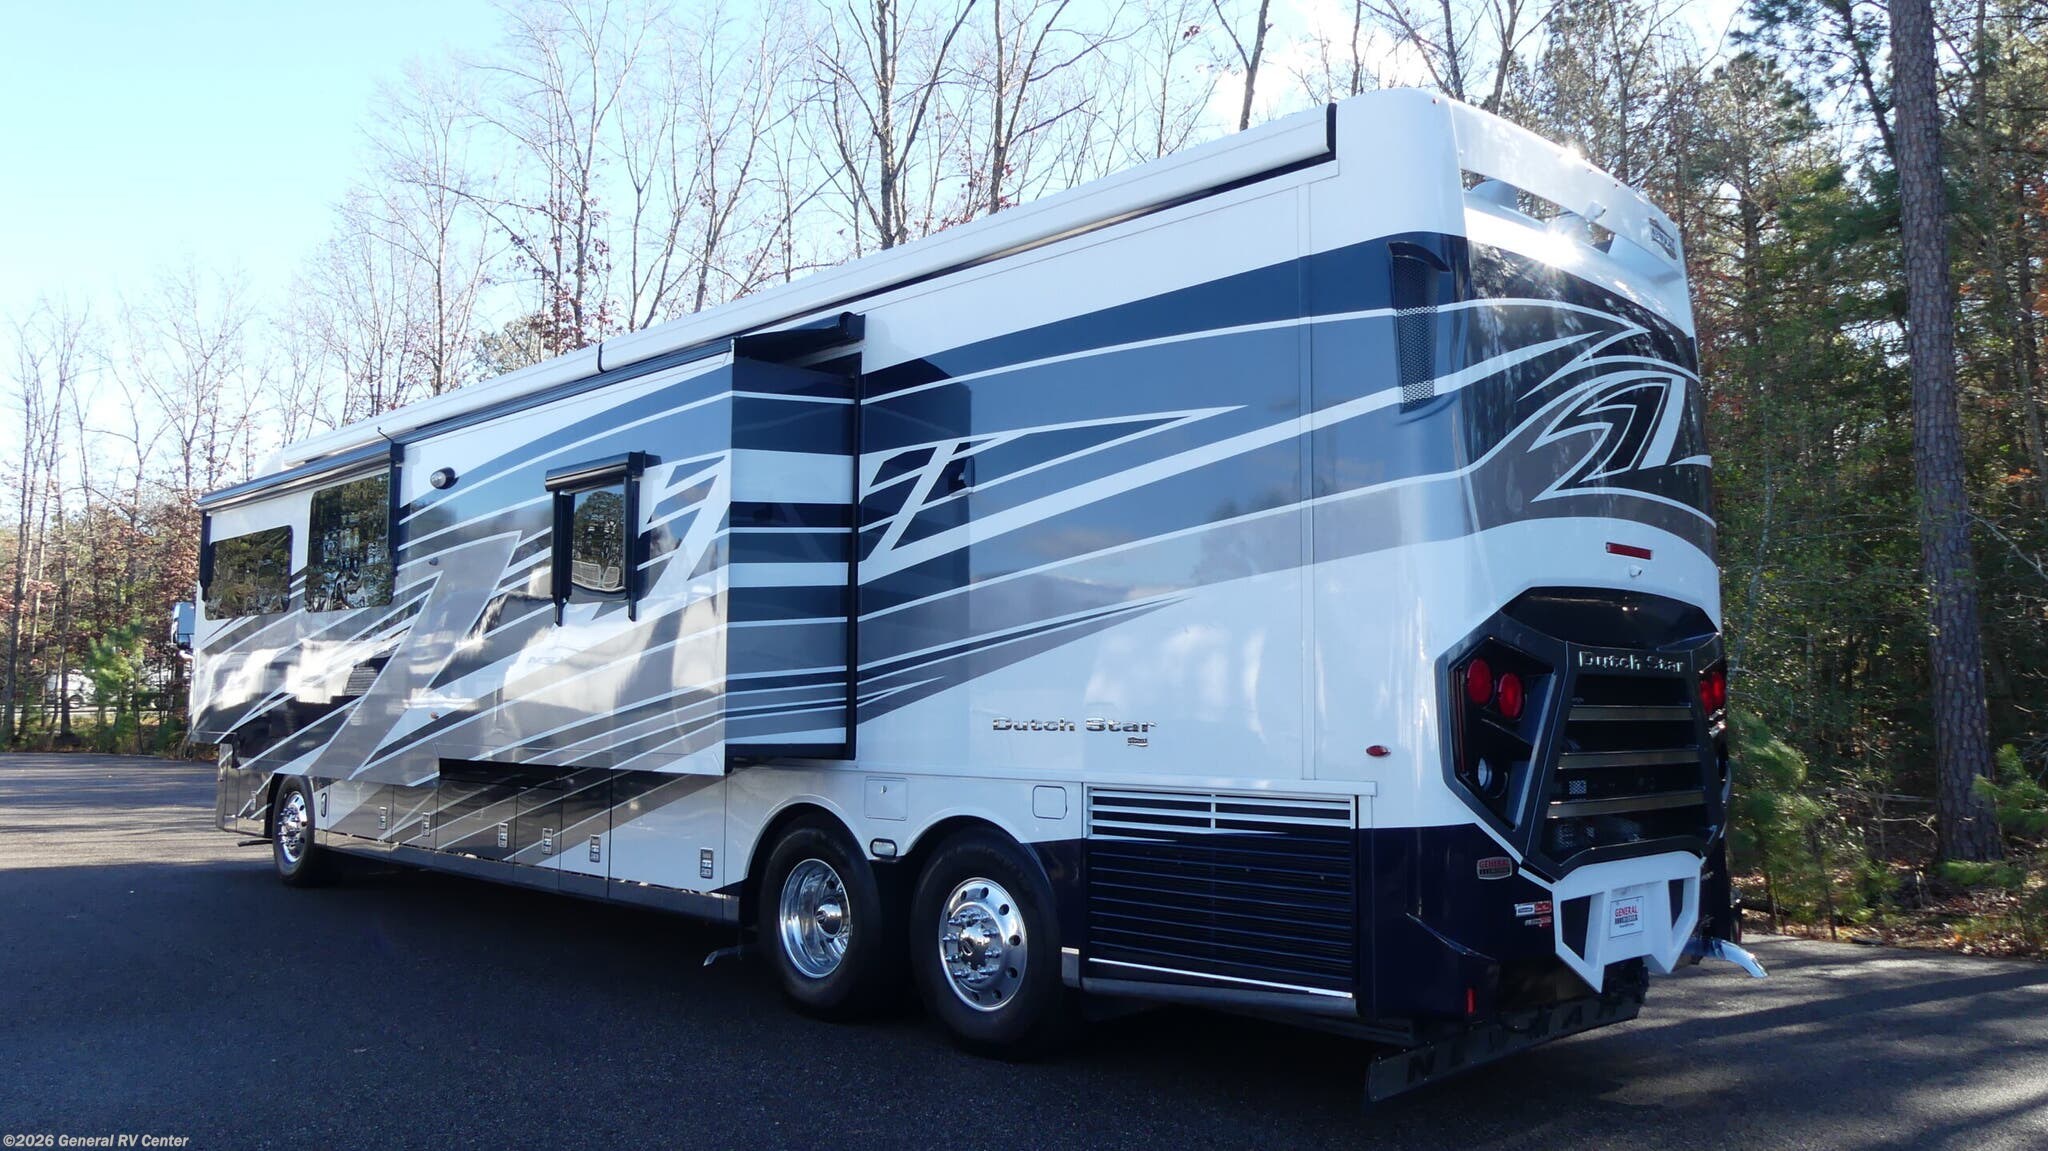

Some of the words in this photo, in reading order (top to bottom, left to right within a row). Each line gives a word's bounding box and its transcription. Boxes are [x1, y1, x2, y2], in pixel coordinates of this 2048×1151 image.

[1579, 651, 1641, 670] Dutch
[1646, 655, 1684, 672] Star
[992, 717, 1076, 732] Dutch
[1085, 717, 1158, 733] Star
[1615, 904, 1638, 917] GENERAL
